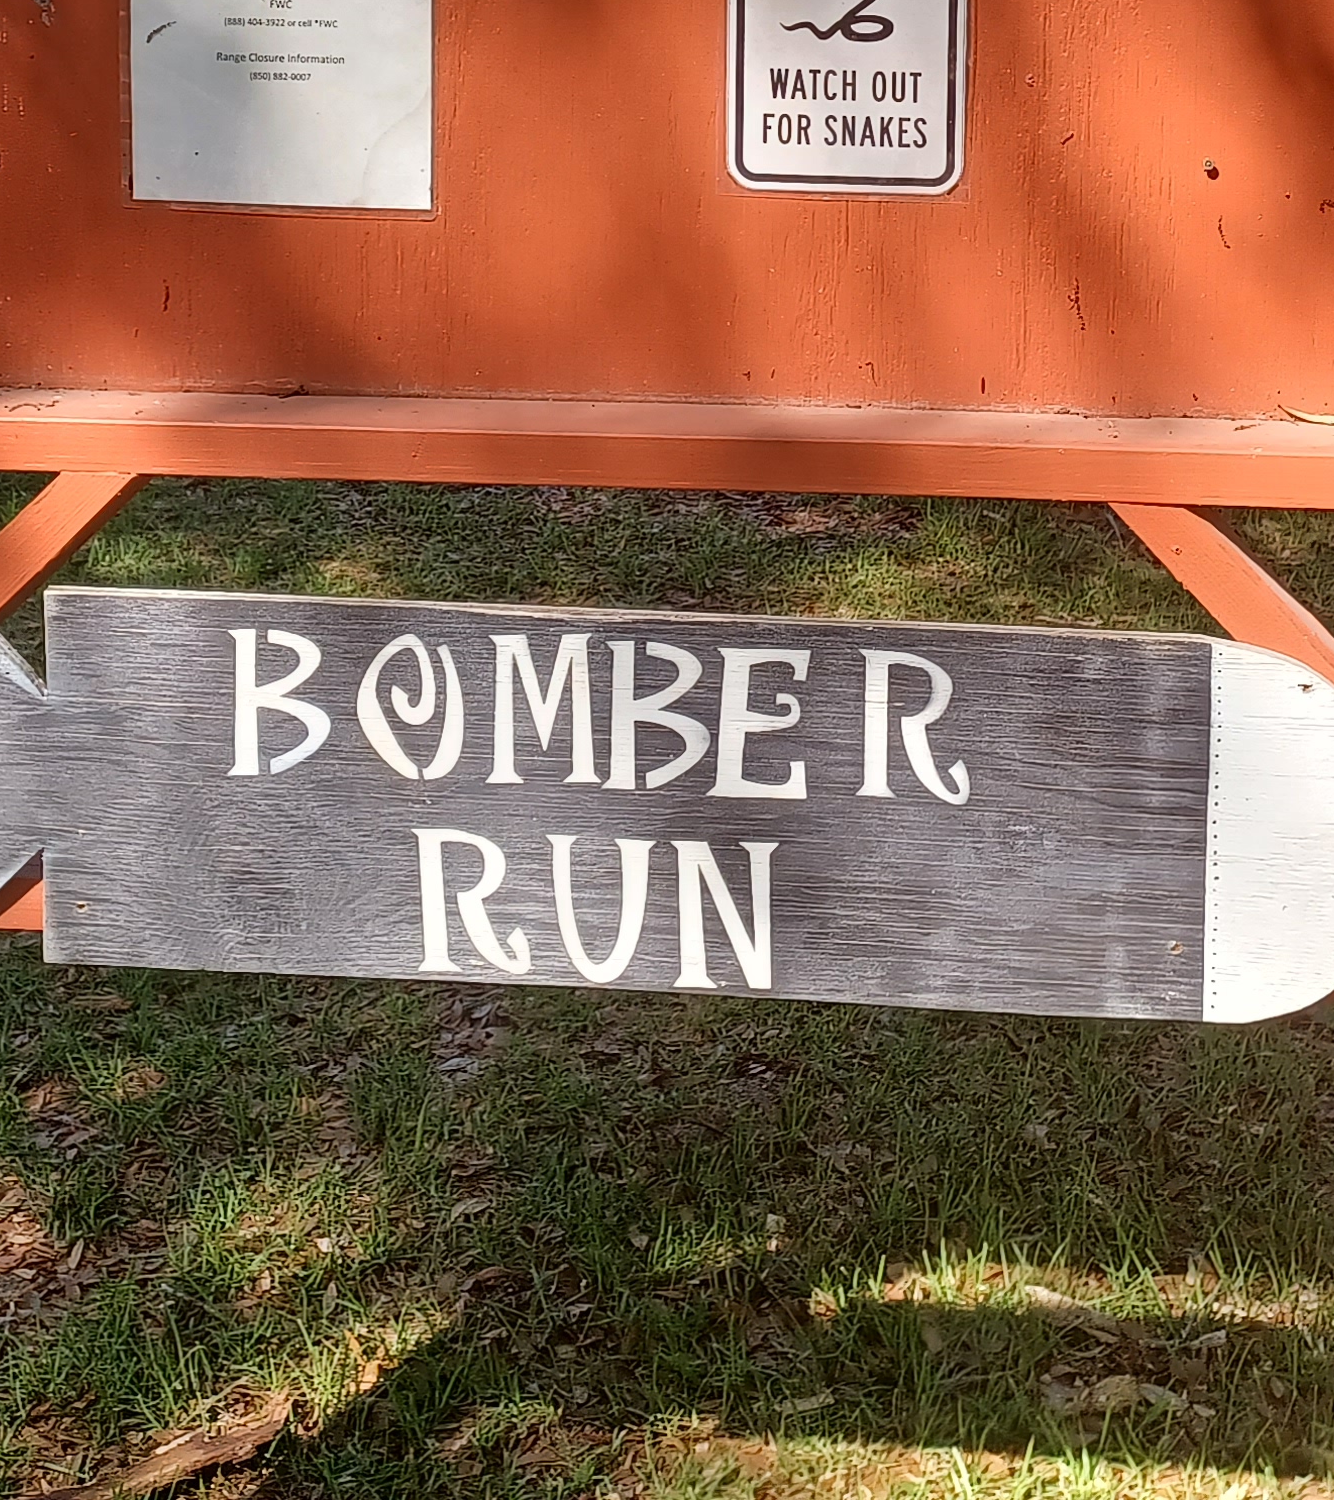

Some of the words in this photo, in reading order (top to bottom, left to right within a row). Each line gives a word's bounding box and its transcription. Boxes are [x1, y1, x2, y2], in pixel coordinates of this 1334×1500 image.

[270, 0, 292, 9] FWC
[248, 18, 285, 27] 404-3922
[298, 19, 312, 27] cell
[216, 52, 246, 63] Range
[249, 53, 285, 63] Closure
[288, 54, 345, 64] Information
[249, 72, 271, 81] (850)
[769, 68, 856, 101] WATCH
[872, 71, 922, 103] OUT
[763, 113, 811, 145] FOR
[824, 114, 928, 149] SNAKES
[226, 628, 971, 806] BOMBER
[410, 827, 780, 990] RUN
